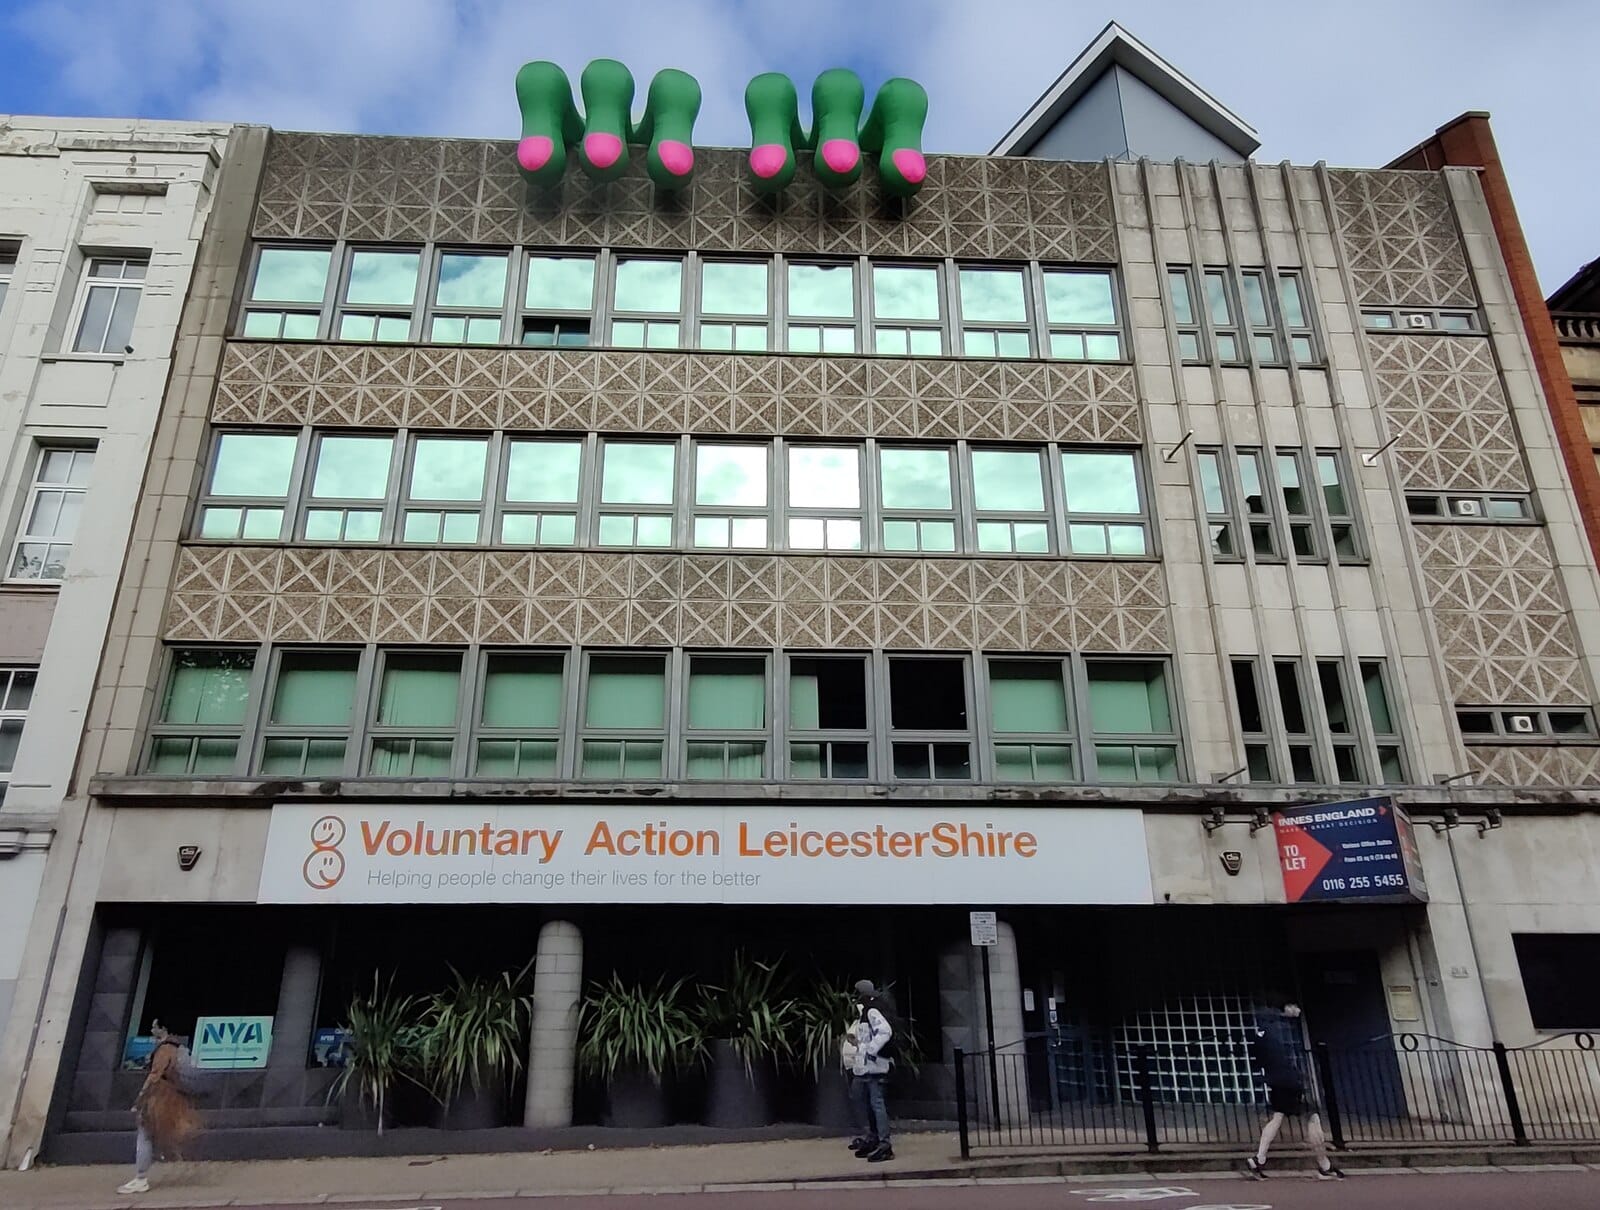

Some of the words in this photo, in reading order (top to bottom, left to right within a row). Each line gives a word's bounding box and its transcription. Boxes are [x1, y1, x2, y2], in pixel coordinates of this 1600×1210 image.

[1279, 815, 1313, 826] INNES
[1314, 808, 1376, 822] ENGLAND
[361, 821, 563, 864] Voluntary
[584, 821, 719, 857] Action
[739, 822, 1038, 857] LeicesterShire
[1283, 845, 1299, 857] TO
[1285, 857, 1307, 870] LET
[367, 870, 432, 889] Helping
[438, 870, 497, 888] people
[502, 870, 565, 889] change
[571, 870, 607, 885] their
[612, 870, 648, 885] lives
[654, 870, 675, 885] for
[681, 871, 707, 885] the
[712, 870, 761, 885] better
[1323, 878, 1345, 890] 0116
[1350, 877, 1370, 889] 255
[1375, 874, 1404, 887] 5455
[202, 1022, 264, 1044] NYA
